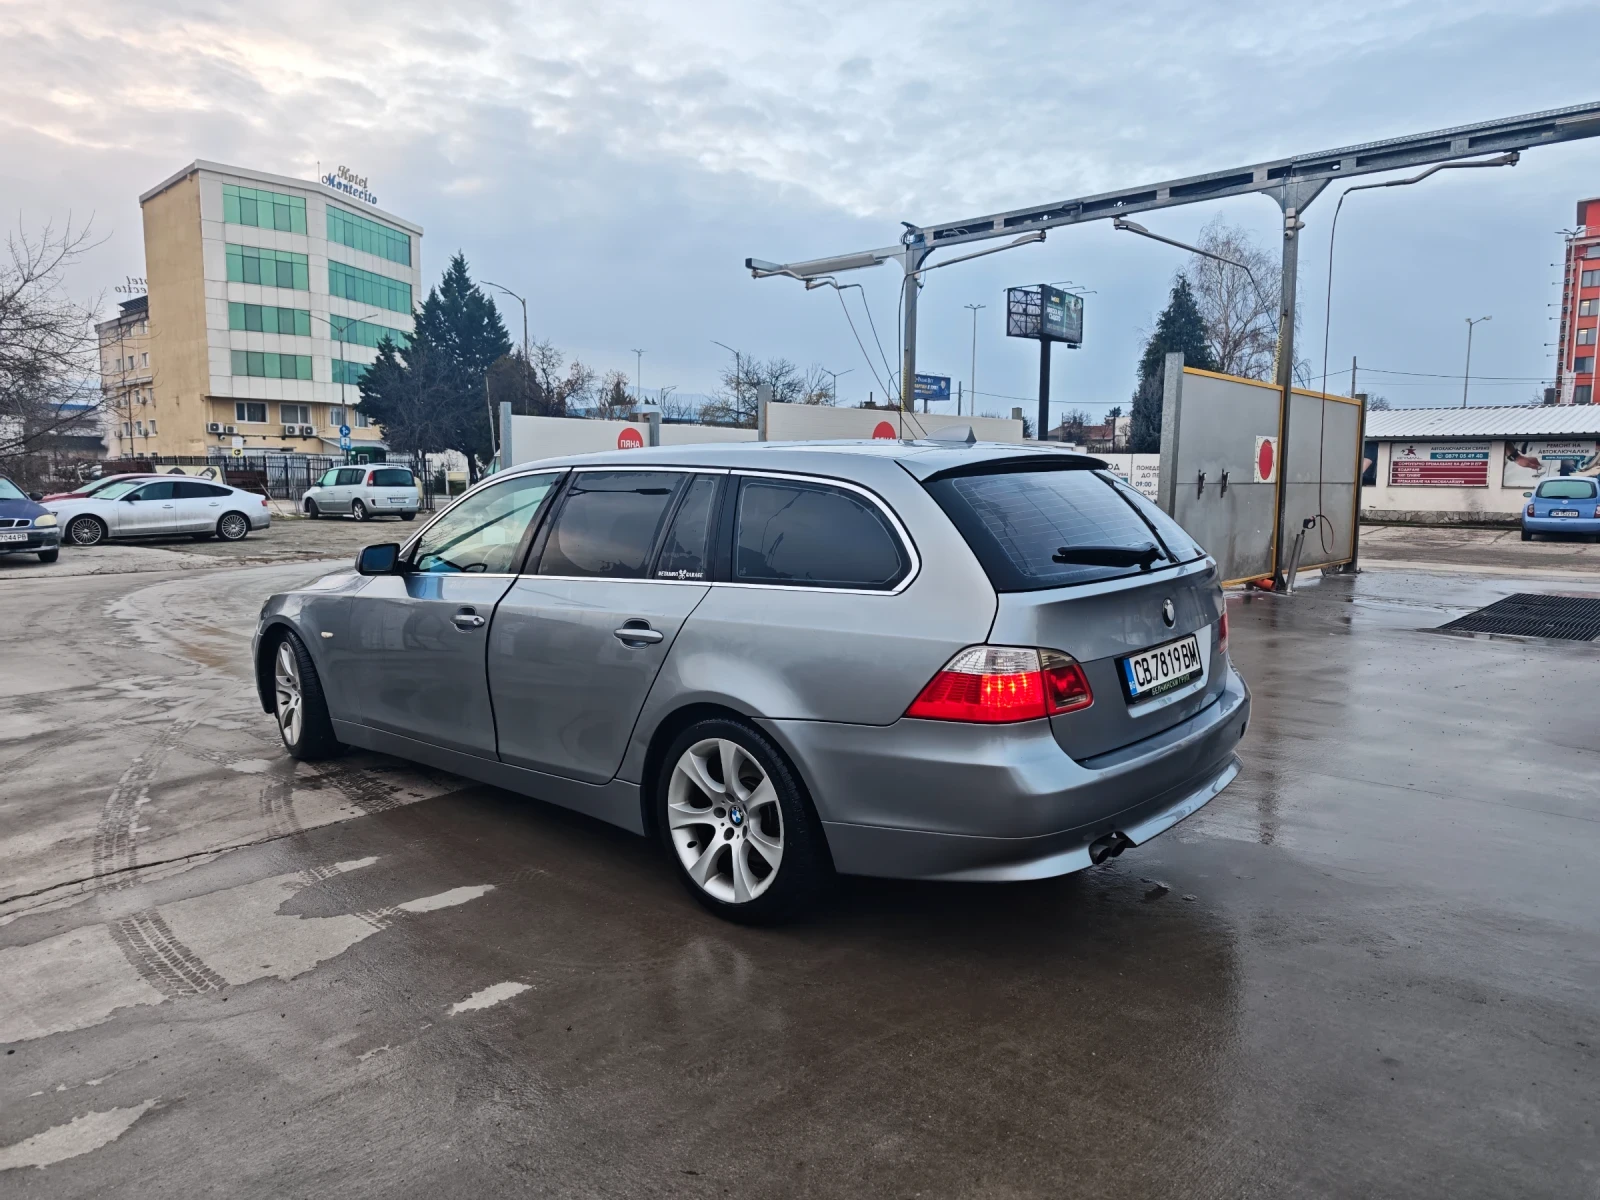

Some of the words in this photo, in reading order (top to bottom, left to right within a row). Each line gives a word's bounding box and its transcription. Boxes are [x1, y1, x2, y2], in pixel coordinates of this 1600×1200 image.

[337, 165, 368, 188] Hotel
[321, 172, 377, 205] Montecito
[620, 439, 640, 448] ПЯНА
